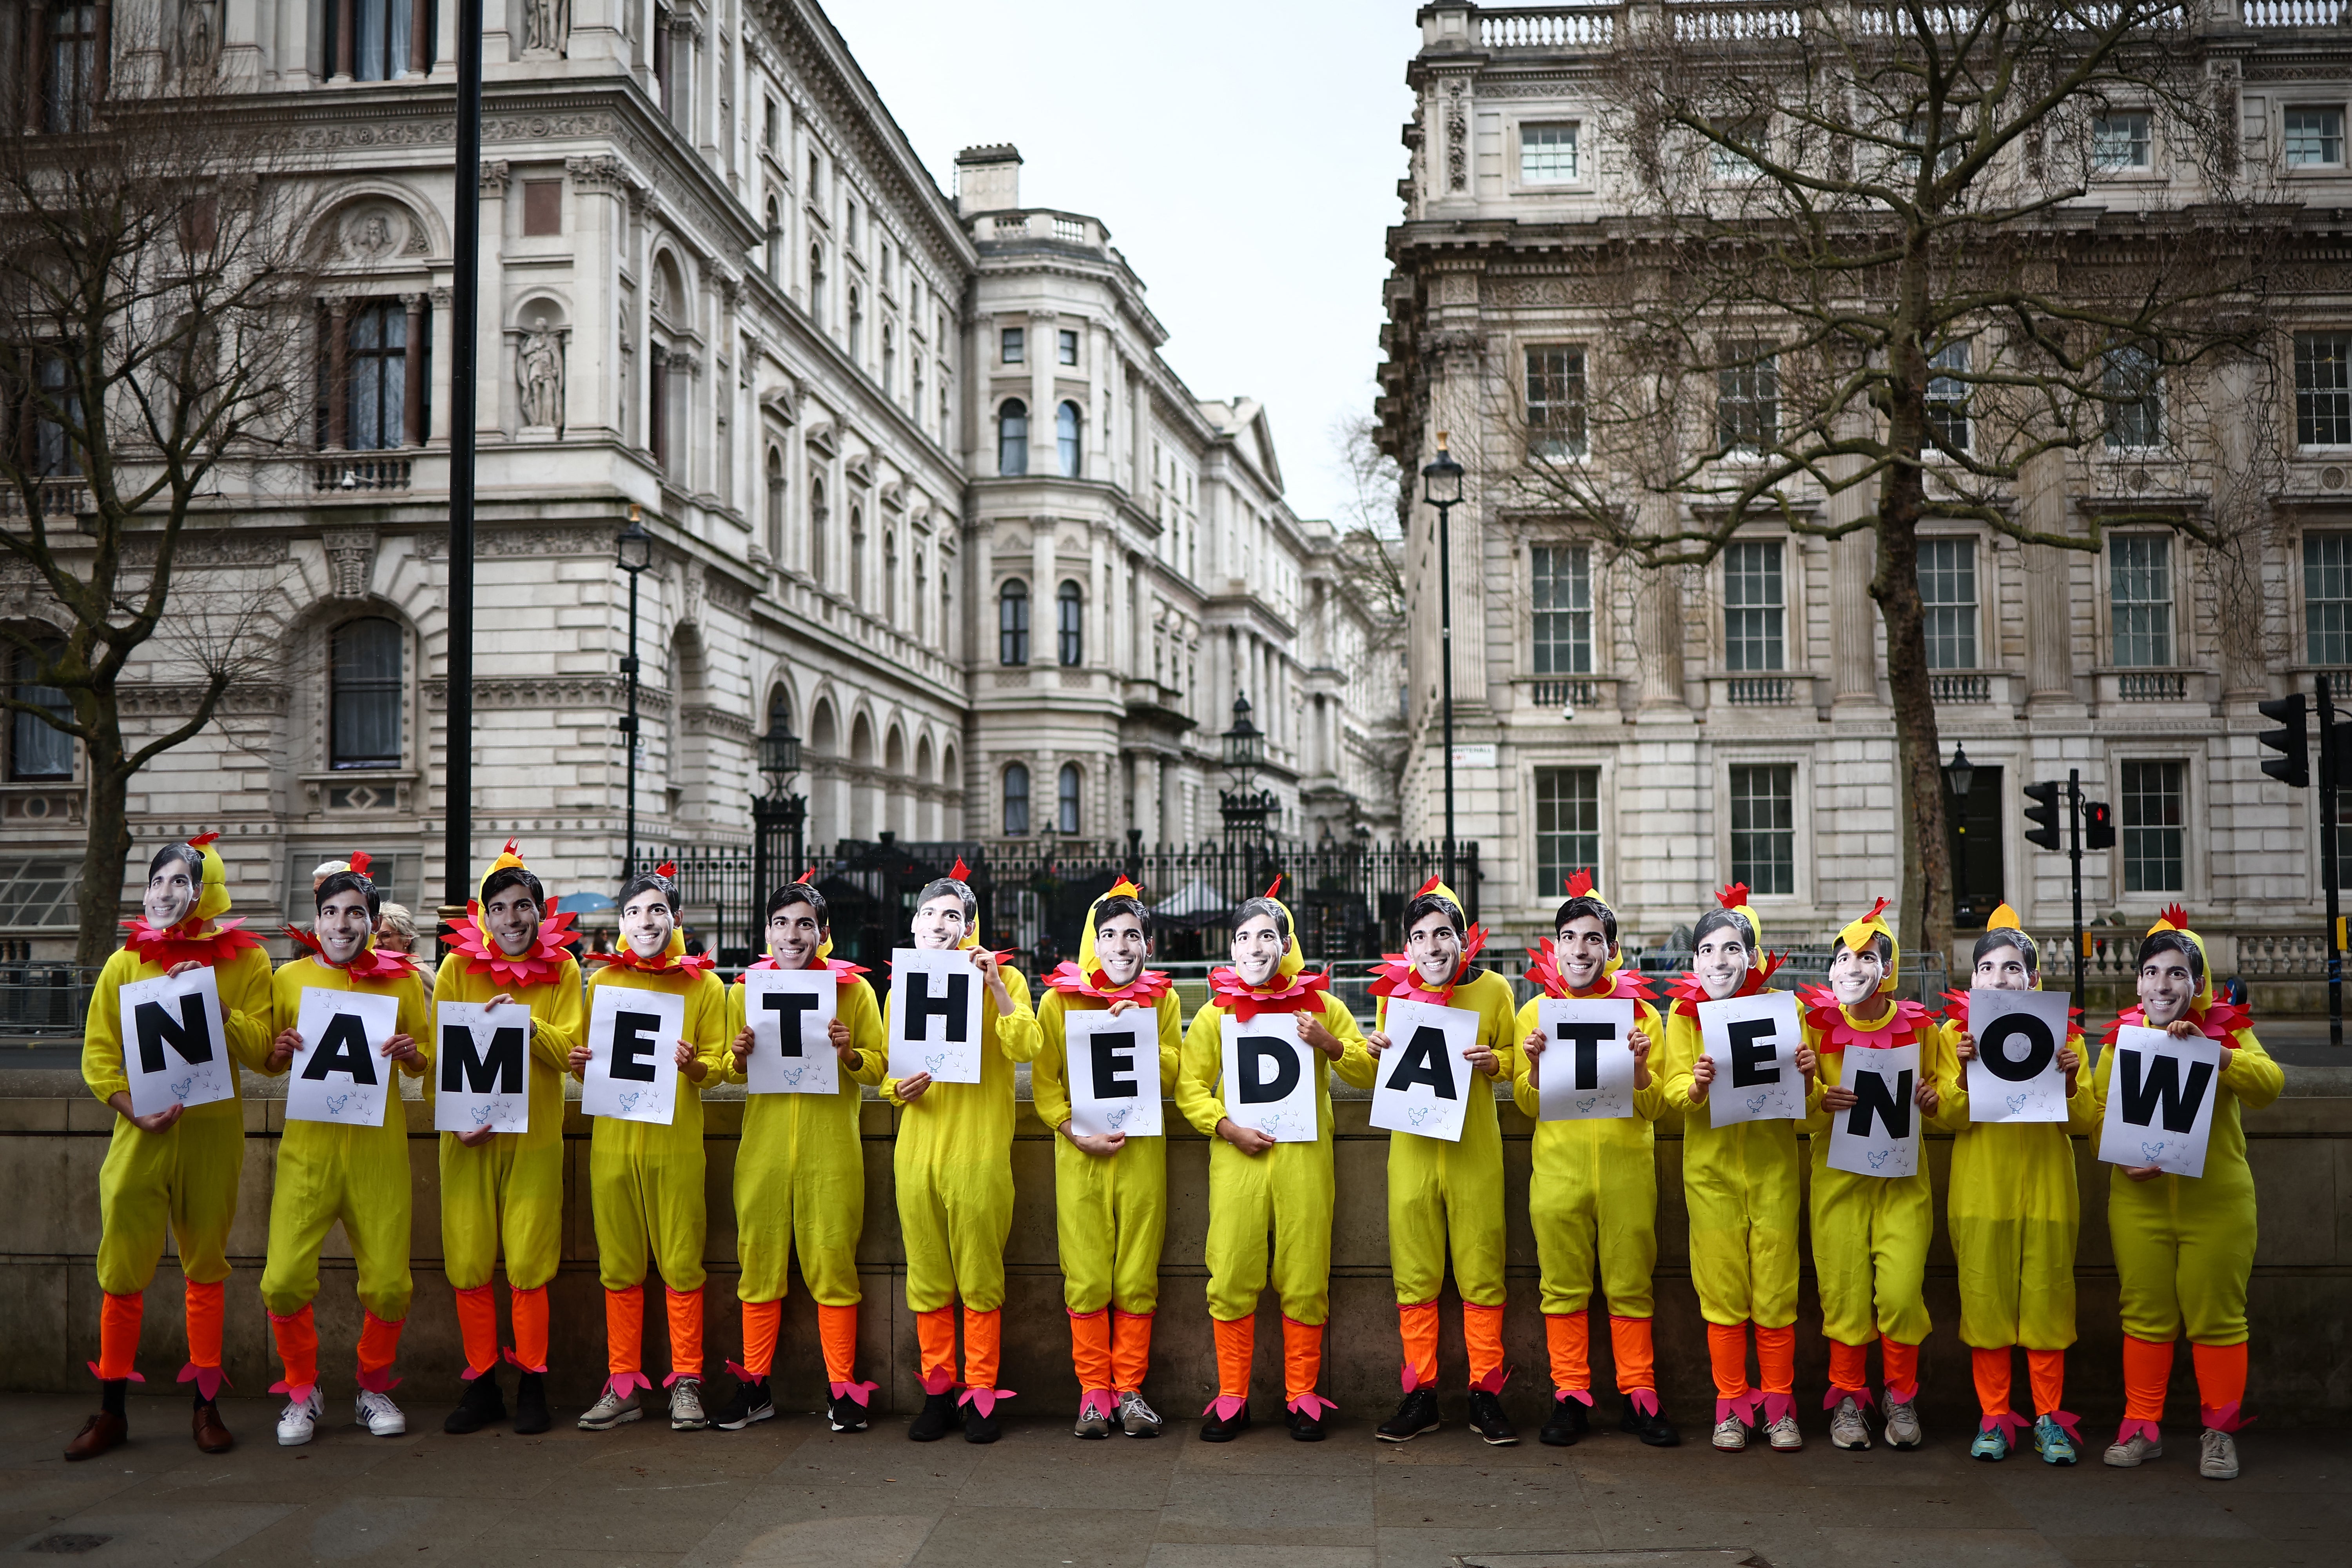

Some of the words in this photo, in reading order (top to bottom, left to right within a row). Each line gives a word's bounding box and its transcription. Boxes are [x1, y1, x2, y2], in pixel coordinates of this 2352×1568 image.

[135, 993, 213, 1074] N
[763, 993, 818, 1057] T
[905, 973, 969, 1042] H
[301, 1013, 377, 1085] A
[442, 1025, 523, 1093] M
[610, 1011, 661, 1082] E
[1090, 1032, 1138, 1099] E
[1237, 1036, 1300, 1103] D
[1385, 1026, 1457, 1100] A
[1557, 1023, 1615, 1090] T
[1727, 1018, 1780, 1088] E
[1979, 1013, 2054, 1082] O
[1847, 1069, 1913, 1139] N
[2120, 1049, 2214, 1134] W
